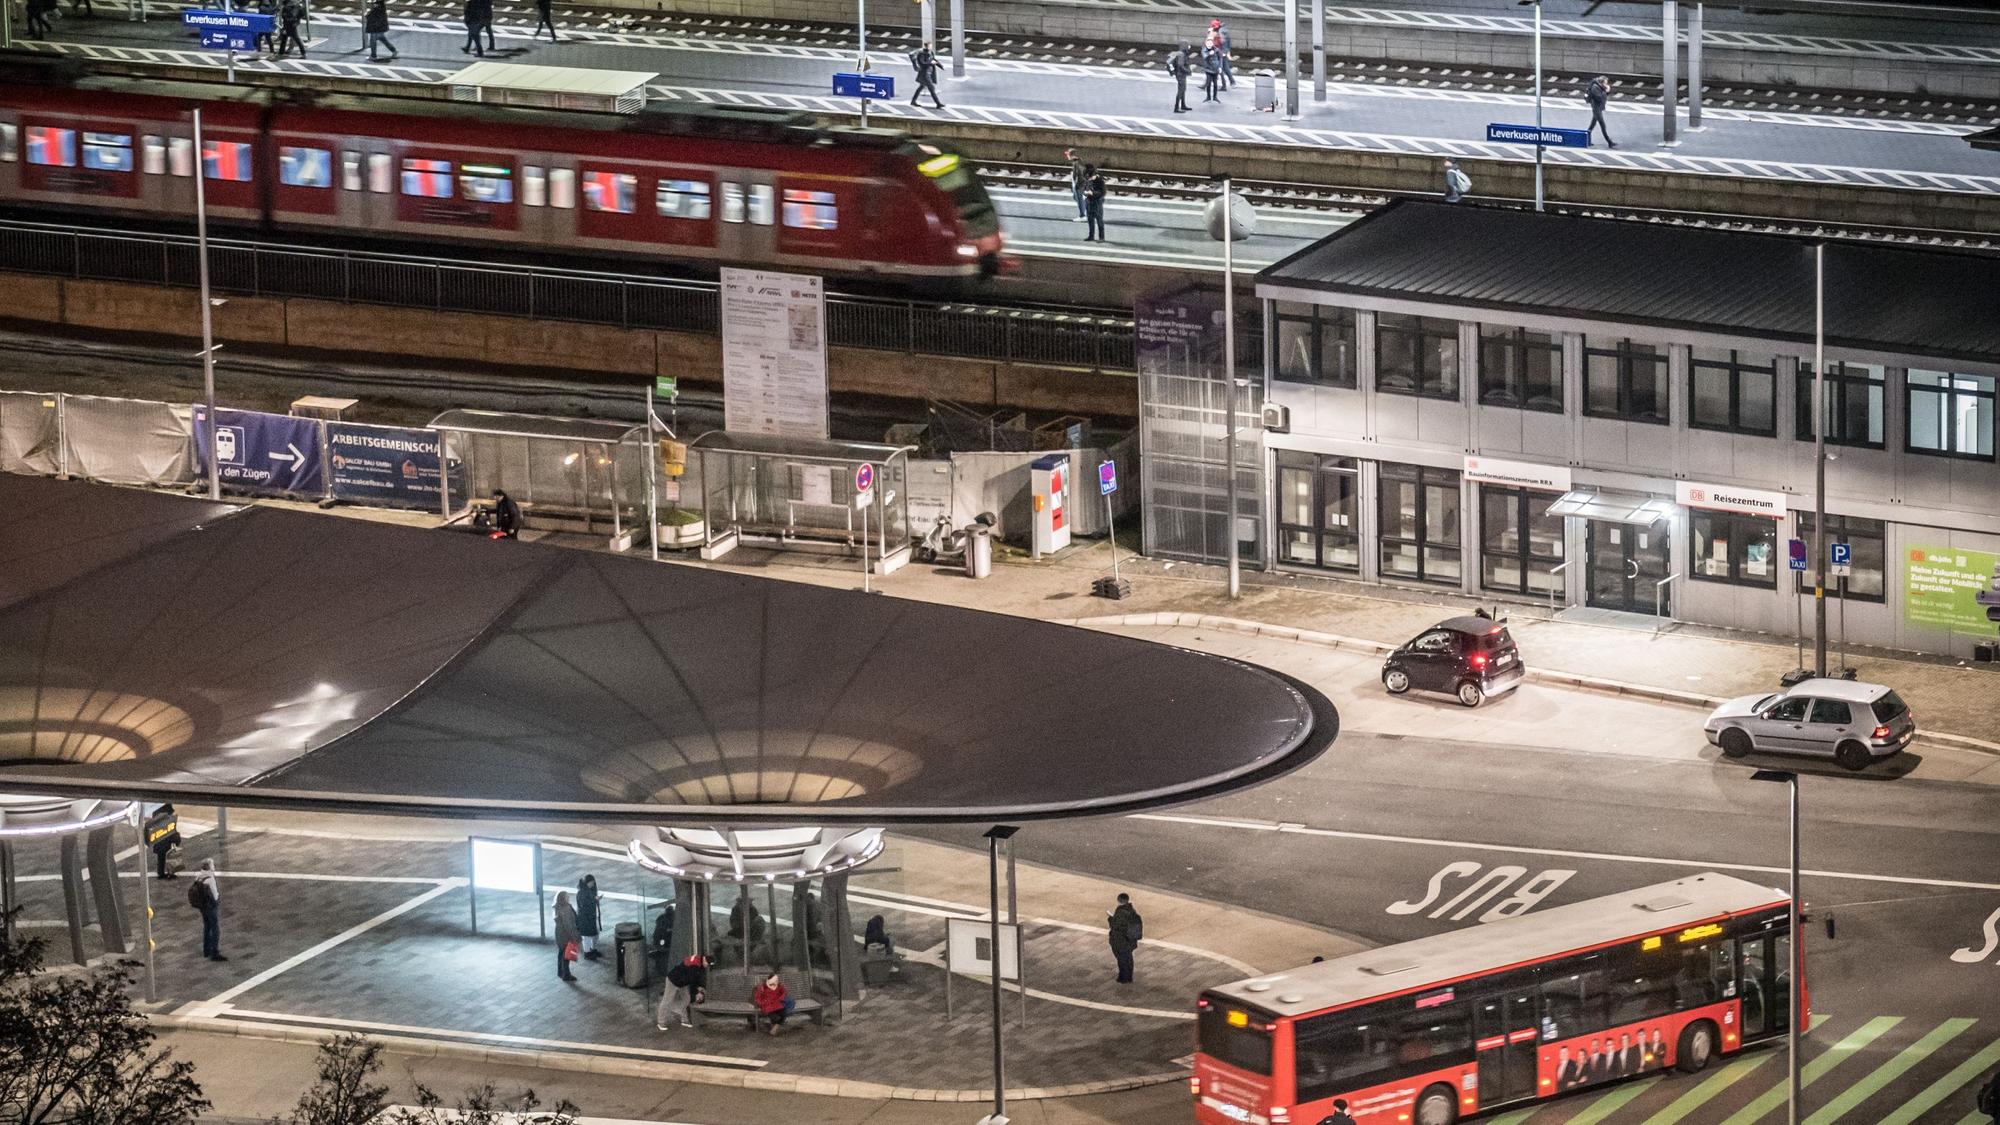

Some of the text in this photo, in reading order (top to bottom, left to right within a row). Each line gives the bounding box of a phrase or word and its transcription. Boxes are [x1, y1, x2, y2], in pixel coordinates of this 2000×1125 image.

[186, 14, 248, 27] Leverkusen Mitte
[1491, 128, 1563, 143] Leverkusen Mitte
[332, 434, 439, 454] ARBEITSGEMEINSCHA
[225, 467, 241, 476] den
[242, 468, 271, 480] Zügen
[1468, 470, 1539, 485] Bauinformationszentrum
[1103, 481, 1115, 491] TAXI
[1690, 490, 1773, 509] DB Reisezentrum
[1835, 546, 1846, 562] P
[1791, 560, 1806, 569] TAXI
[1911, 573, 1983, 590] Zukunft der Mobilität
[1933, 568, 1960, 578] Zukunft
[1961, 571, 1975, 580] und
[1911, 582, 1955, 594] zu gestalten.
[1385, 861, 1580, 923] BUS
